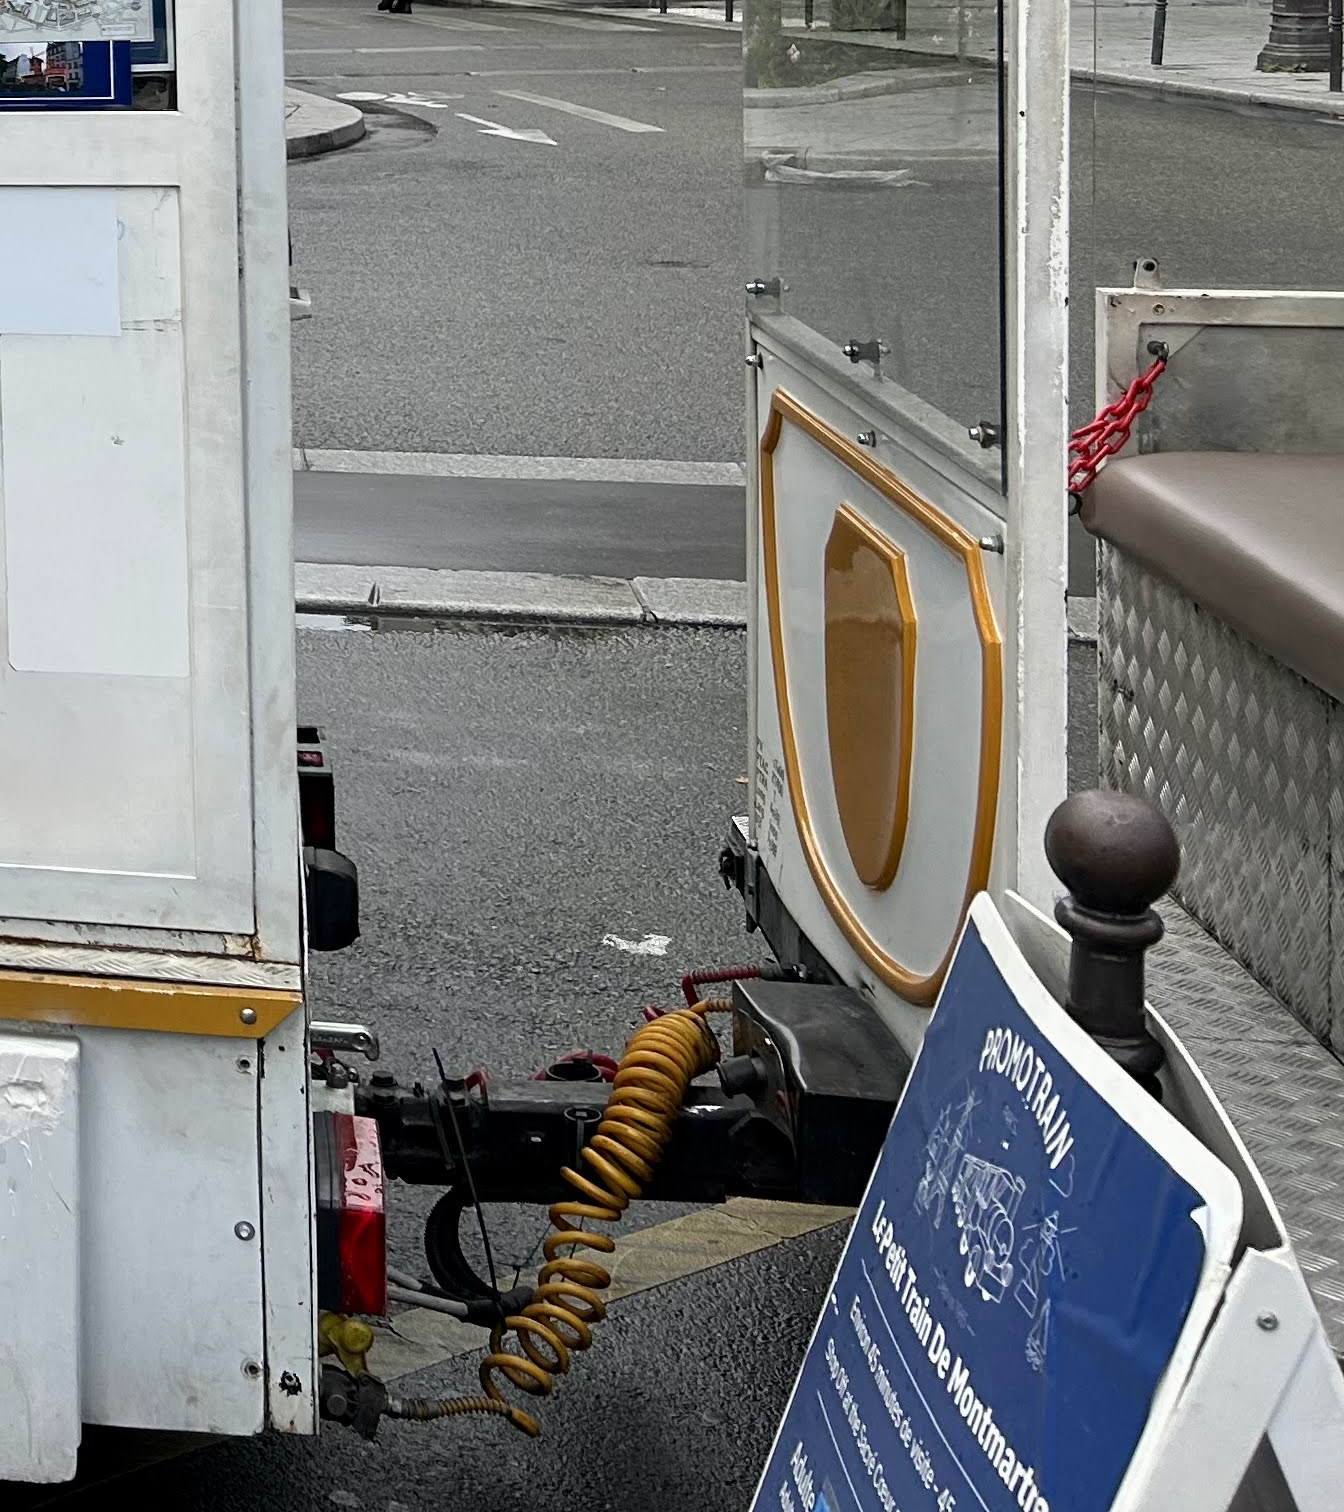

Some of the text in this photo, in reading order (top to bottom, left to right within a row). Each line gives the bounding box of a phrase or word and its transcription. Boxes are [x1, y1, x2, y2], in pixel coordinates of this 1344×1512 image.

[979, 1027, 1075, 1170] PROMOTRAIN
[866, 1343, 882, 1374] 45
[875, 1363, 904, 1429] minutes
[910, 1436, 936, 1490] visite
[878, 1221, 909, 1292] Petit
[901, 1266, 934, 1347] Train
[927, 1323, 952, 1380] De
[947, 1356, 1050, 1512] Montmartre
[790, 1440, 815, 1510] Adulte
